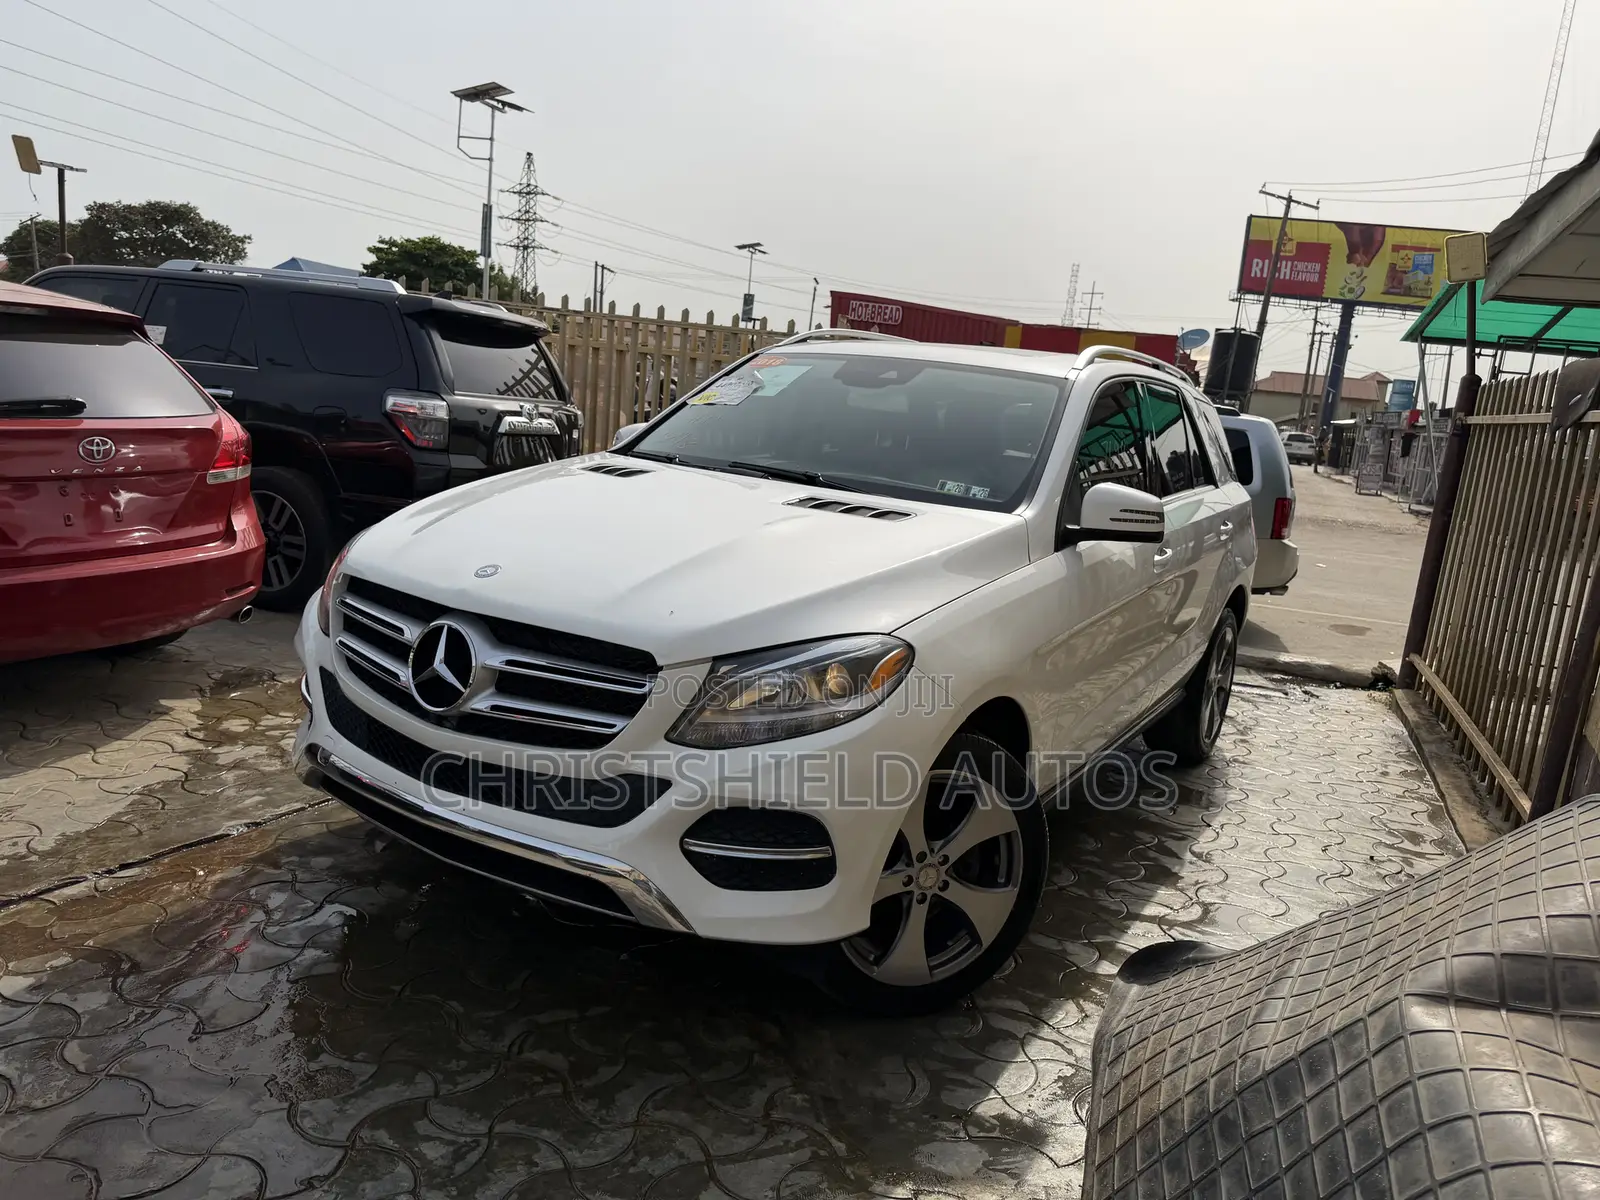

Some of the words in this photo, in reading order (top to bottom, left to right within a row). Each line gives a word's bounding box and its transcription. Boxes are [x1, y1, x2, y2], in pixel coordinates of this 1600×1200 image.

[1251, 259, 1291, 279] RIH
[1293, 261, 1321, 273] CHICKEN
[1291, 272, 1319, 282] FLAVOUR
[49, 465, 142, 474] VENZA
